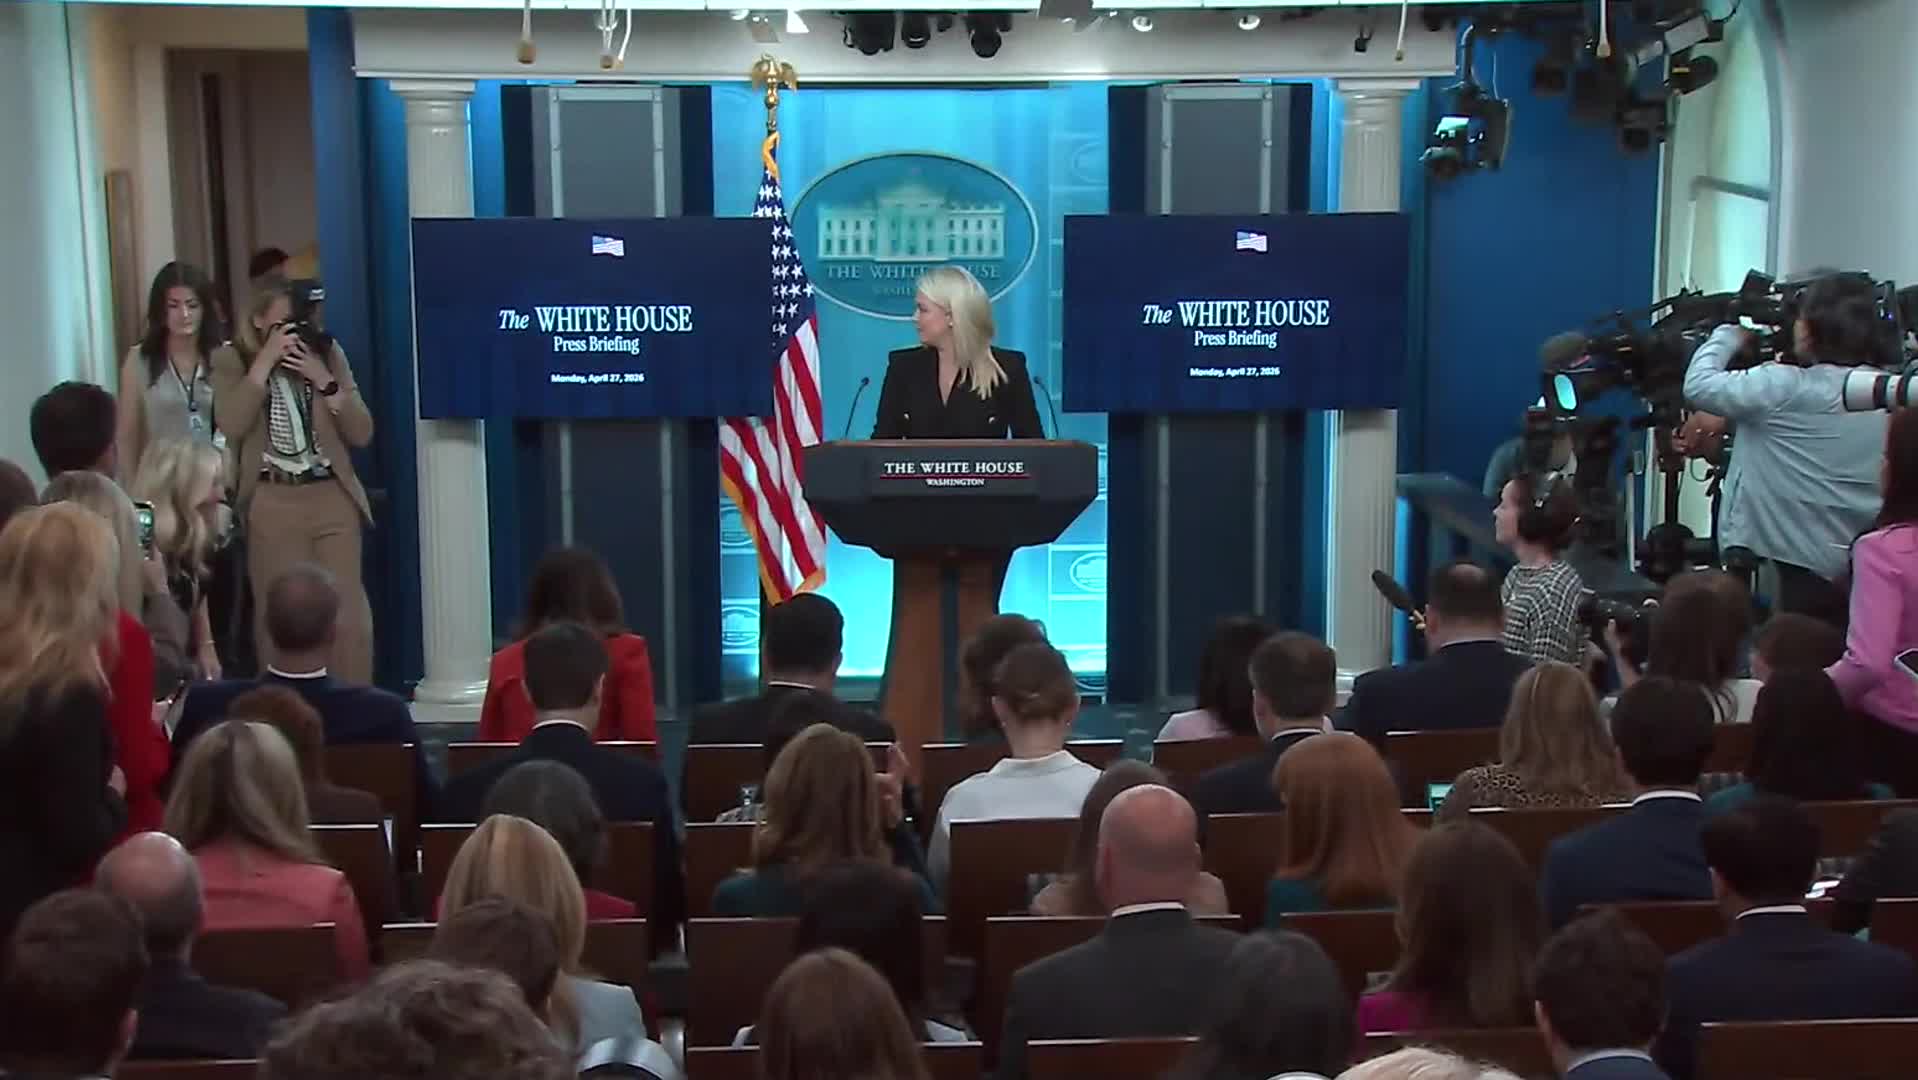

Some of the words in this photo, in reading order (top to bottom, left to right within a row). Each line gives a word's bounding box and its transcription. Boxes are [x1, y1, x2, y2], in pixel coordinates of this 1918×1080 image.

[827, 264, 862, 279] THE
[499, 309, 530, 330] The
[534, 305, 611, 332] WHITE
[614, 305, 693, 332] HOUSE
[1142, 304, 1173, 324] The
[1177, 301, 1250, 327] WHITE
[1254, 300, 1330, 326] HOUSE
[553, 335, 587, 352] Press
[589, 335, 640, 355] Briefing
[1194, 330, 1226, 346] Press
[1228, 329, 1278, 349] Briefing
[551, 373, 587, 384] Monday,
[588, 373, 609, 384] April
[609, 373, 623, 384] 27,
[624, 373, 645, 383] 2026
[1190, 367, 1225, 378] Monday,
[1225, 367, 1246, 378] April
[1246, 367, 1260, 377] 27,
[884, 462, 916, 474] THE
[920, 462, 970, 474] WHITE
[975, 461, 1025, 473] HOUSE
[925, 478, 985, 486] WASHINGTON
